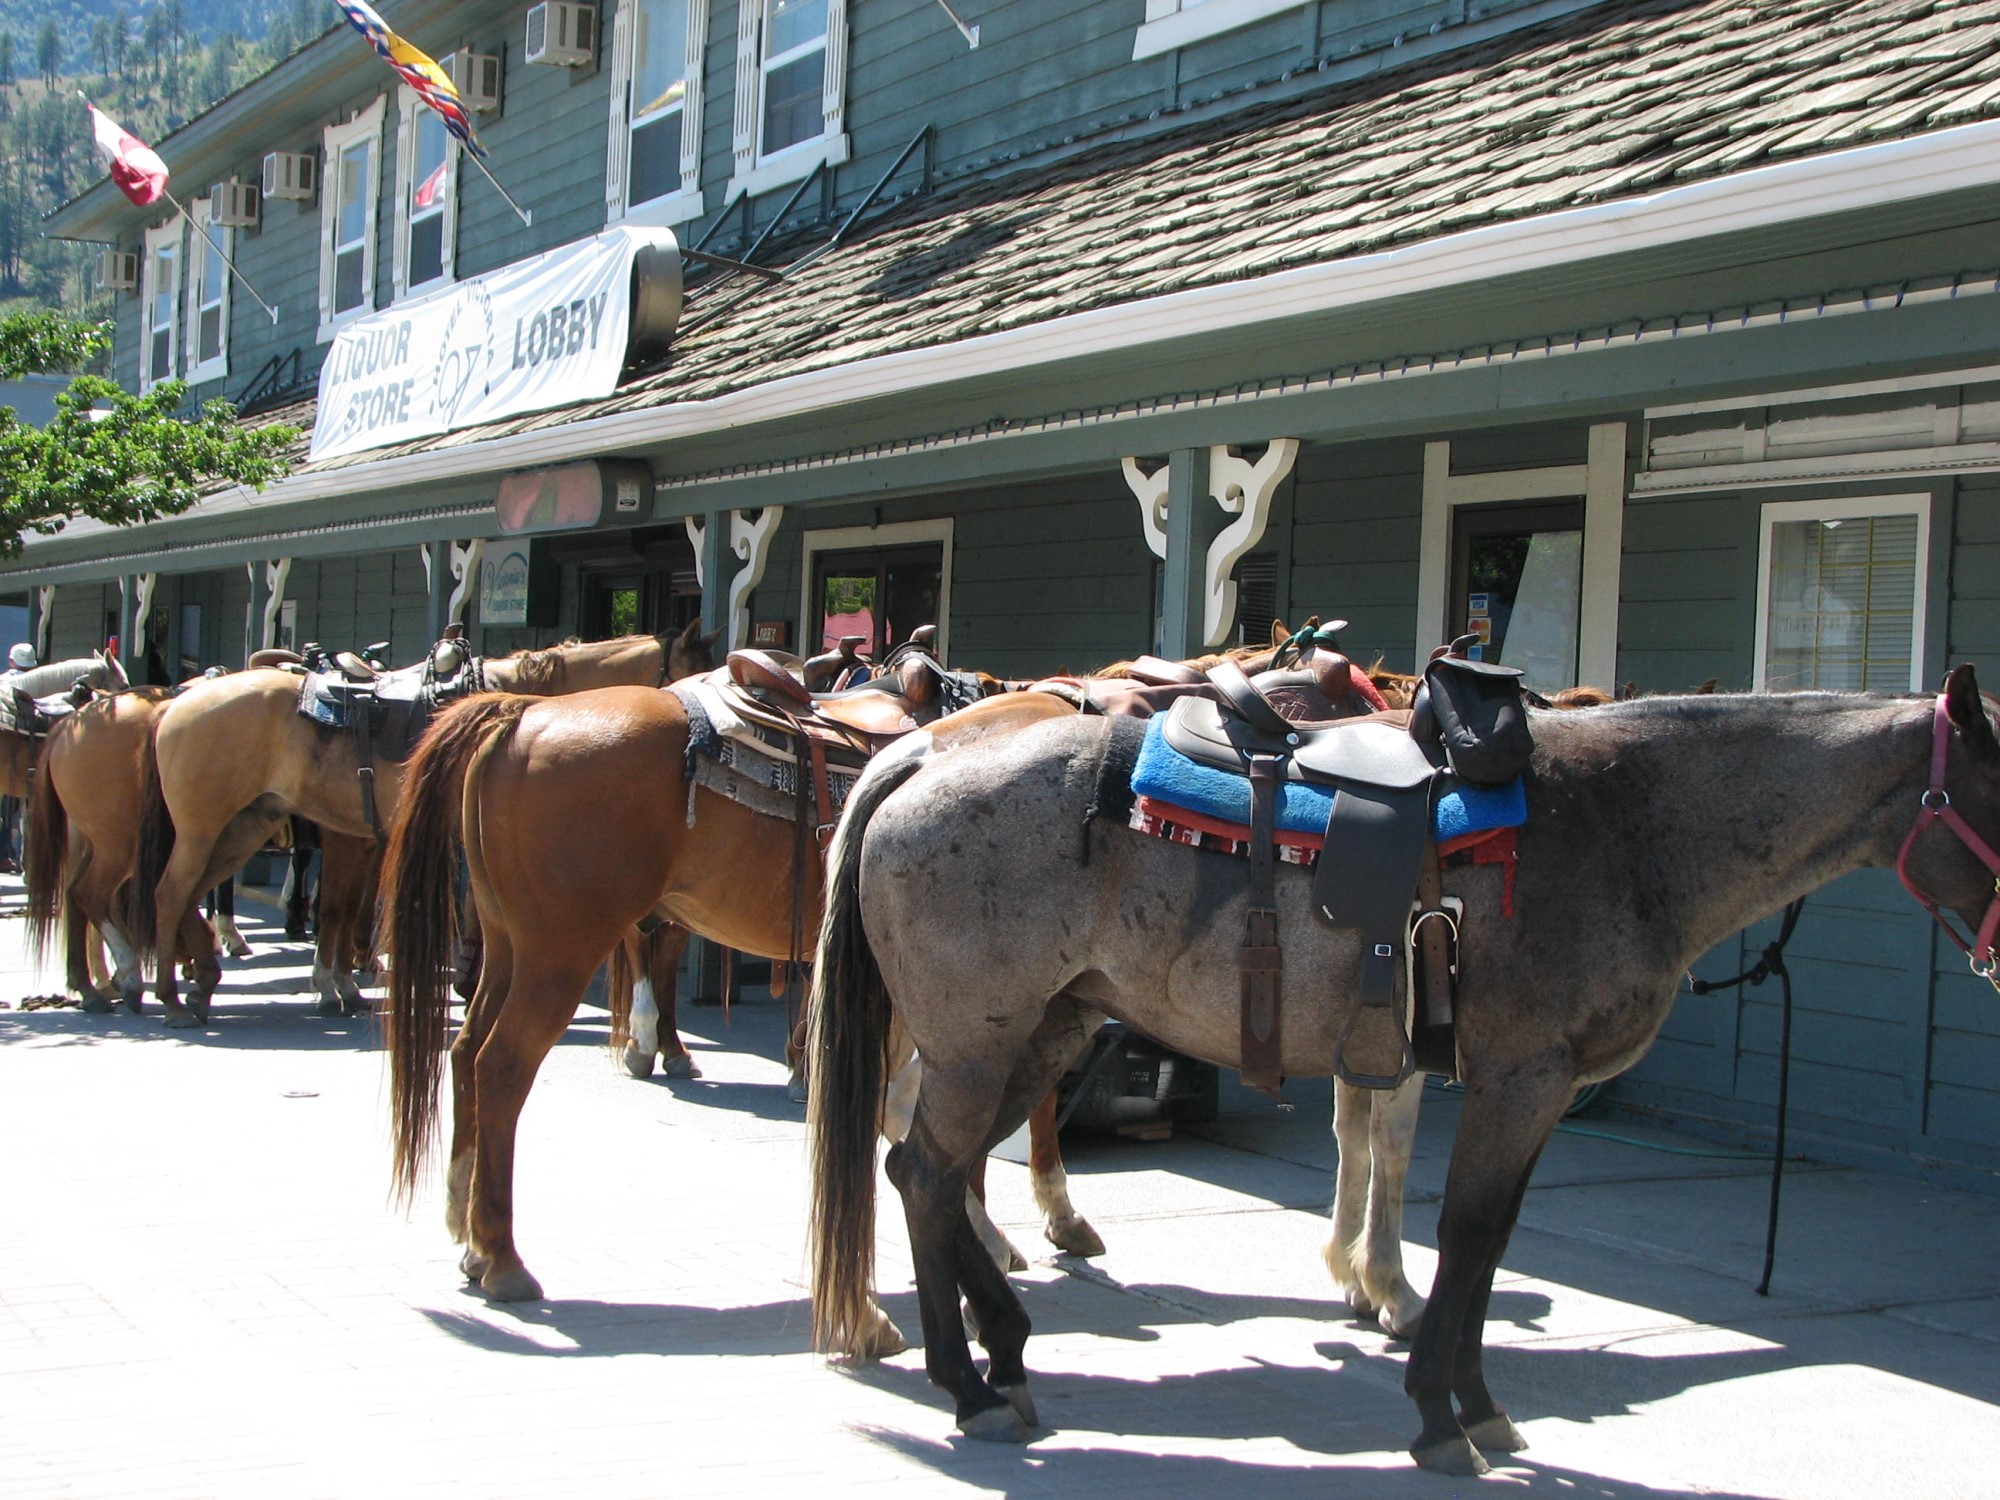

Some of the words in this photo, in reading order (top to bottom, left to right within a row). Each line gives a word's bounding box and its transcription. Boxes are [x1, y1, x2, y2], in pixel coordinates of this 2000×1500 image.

[332, 319, 412, 386] LIQUOR
[511, 291, 608, 371] LOBBY
[343, 378, 415, 433] STORE
